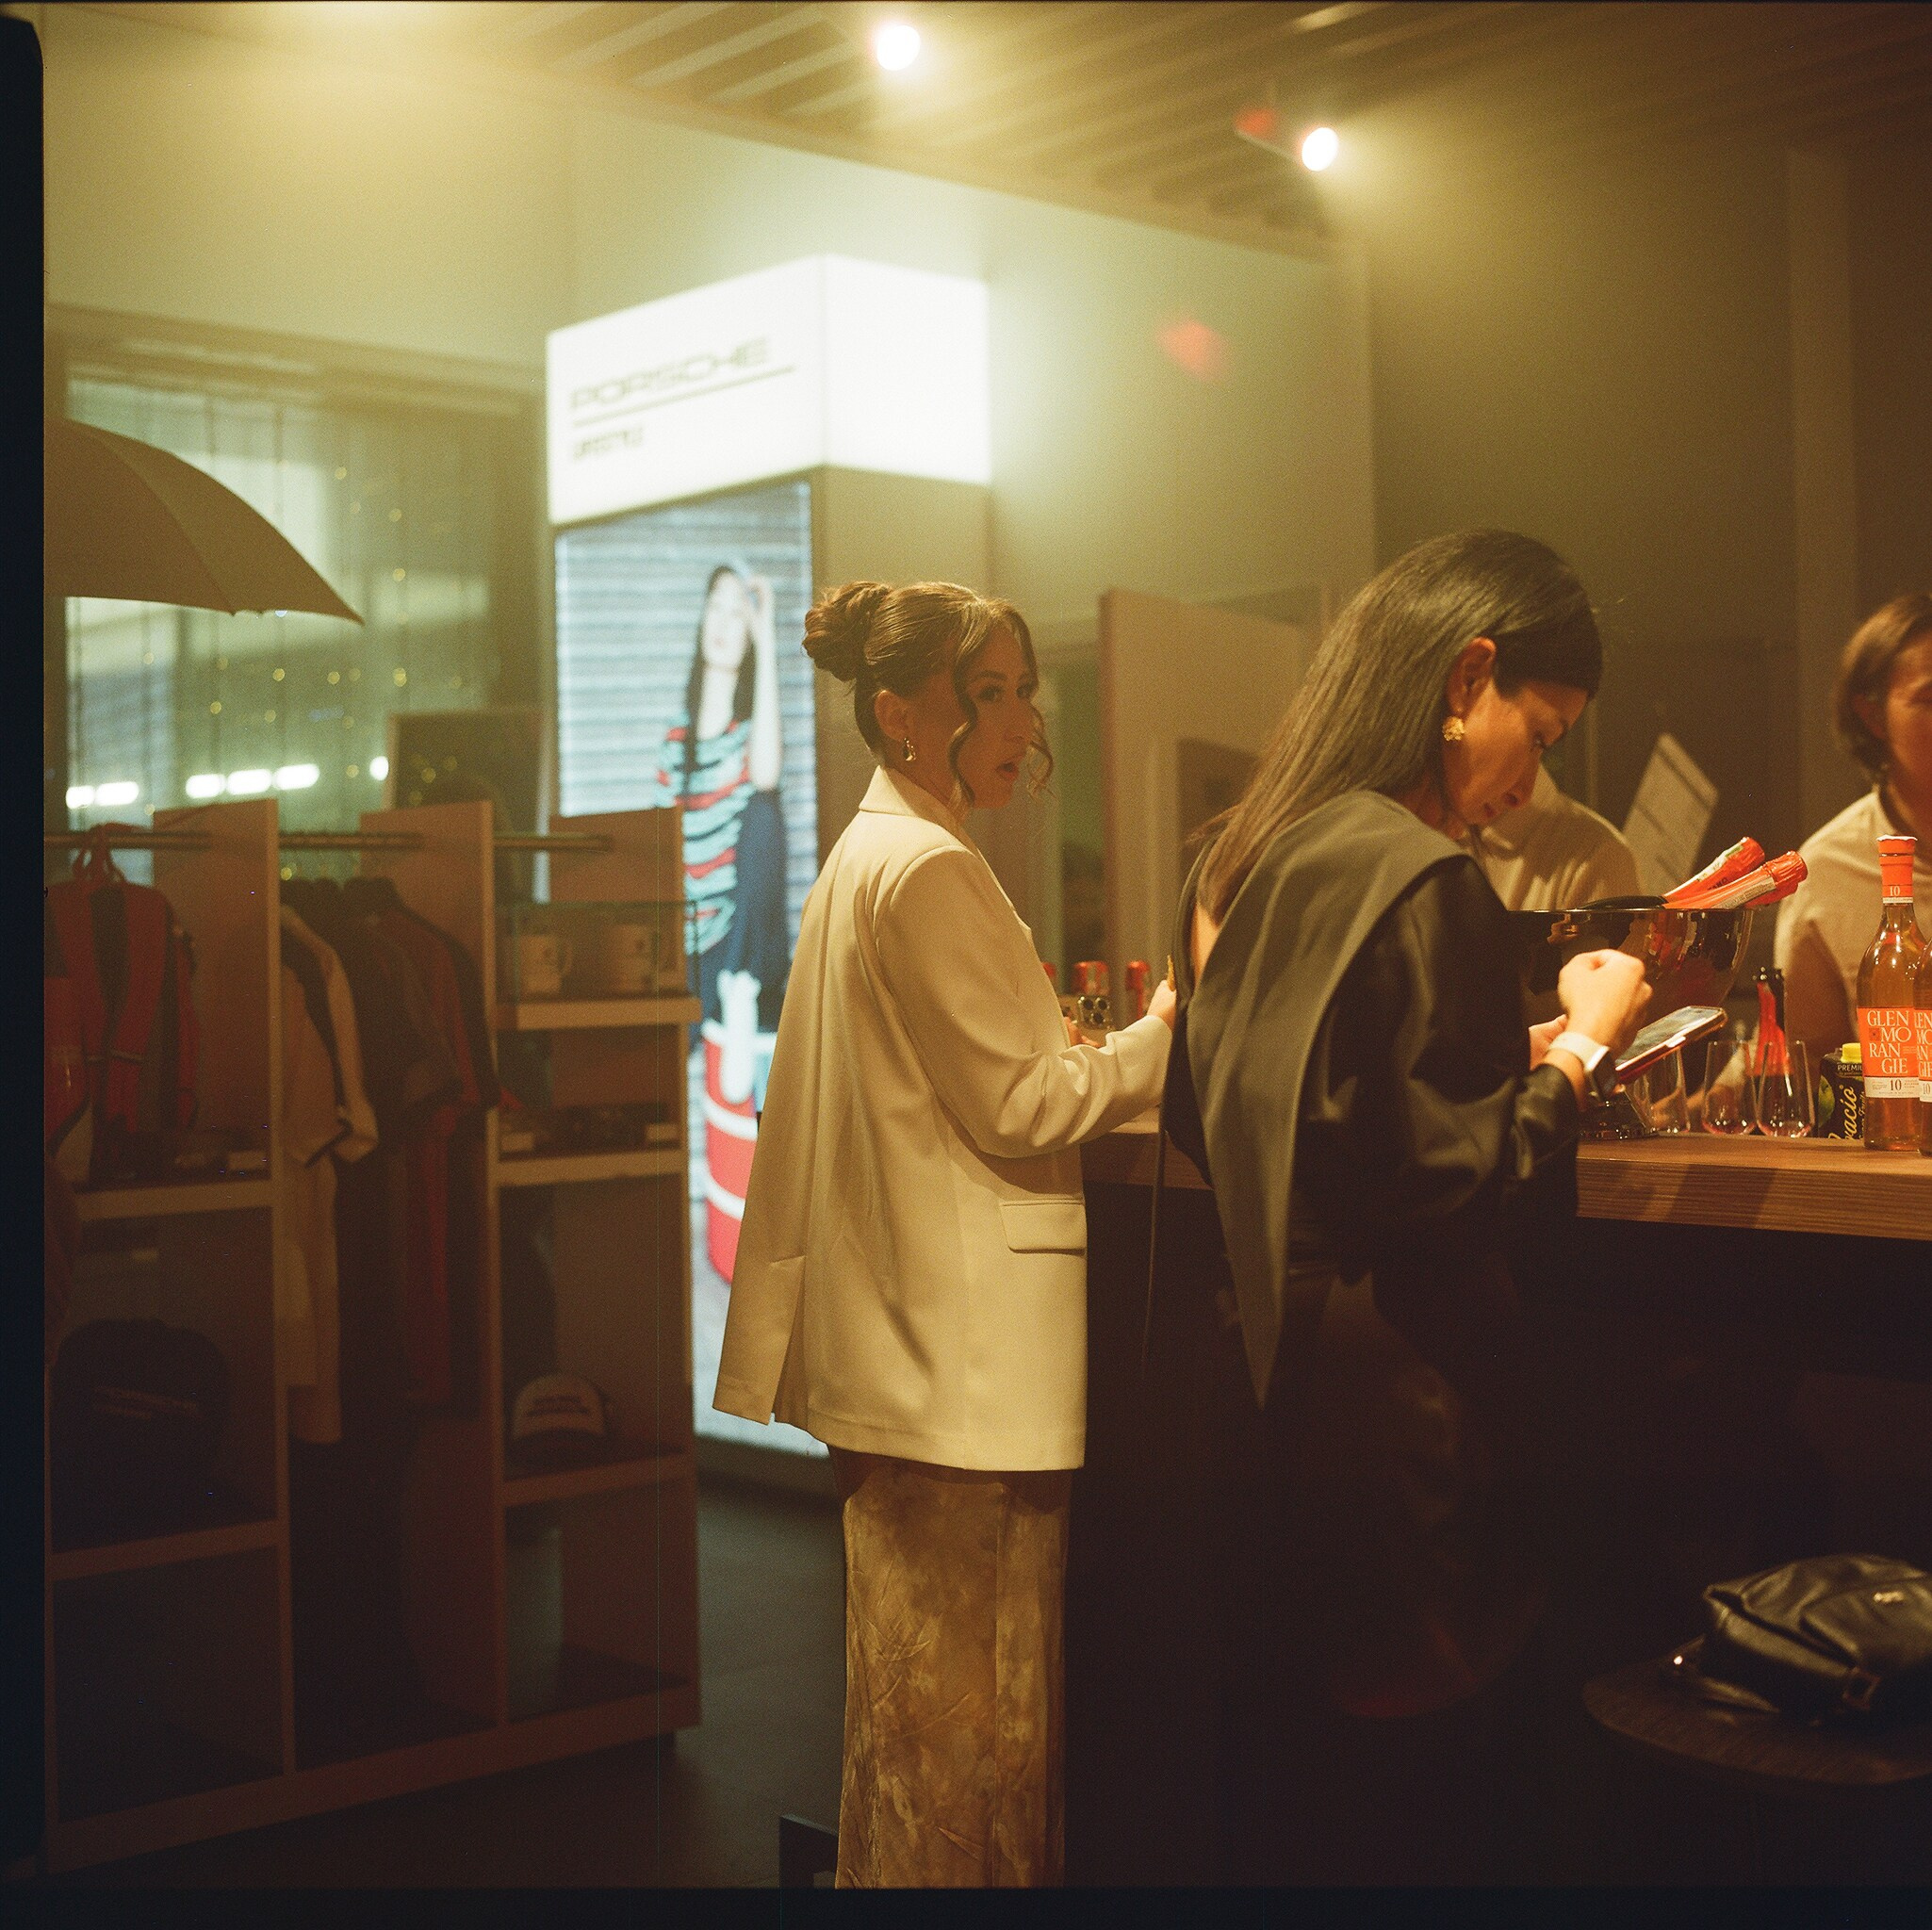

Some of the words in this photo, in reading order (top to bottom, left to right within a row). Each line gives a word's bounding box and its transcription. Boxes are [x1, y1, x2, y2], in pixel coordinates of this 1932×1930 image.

[570, 335, 769, 409] PORSCHE
[1890, 886, 1901, 897] 10
[1867, 1010, 1909, 1027] GLEN
[1914, 1012, 1932, 1029] LEN
[1881, 1027, 1912, 1042] MO
[1869, 1043, 1901, 1057] RAN
[1881, 1058, 1908, 1074] GIE
[1890, 1079, 1902, 1091] 10
